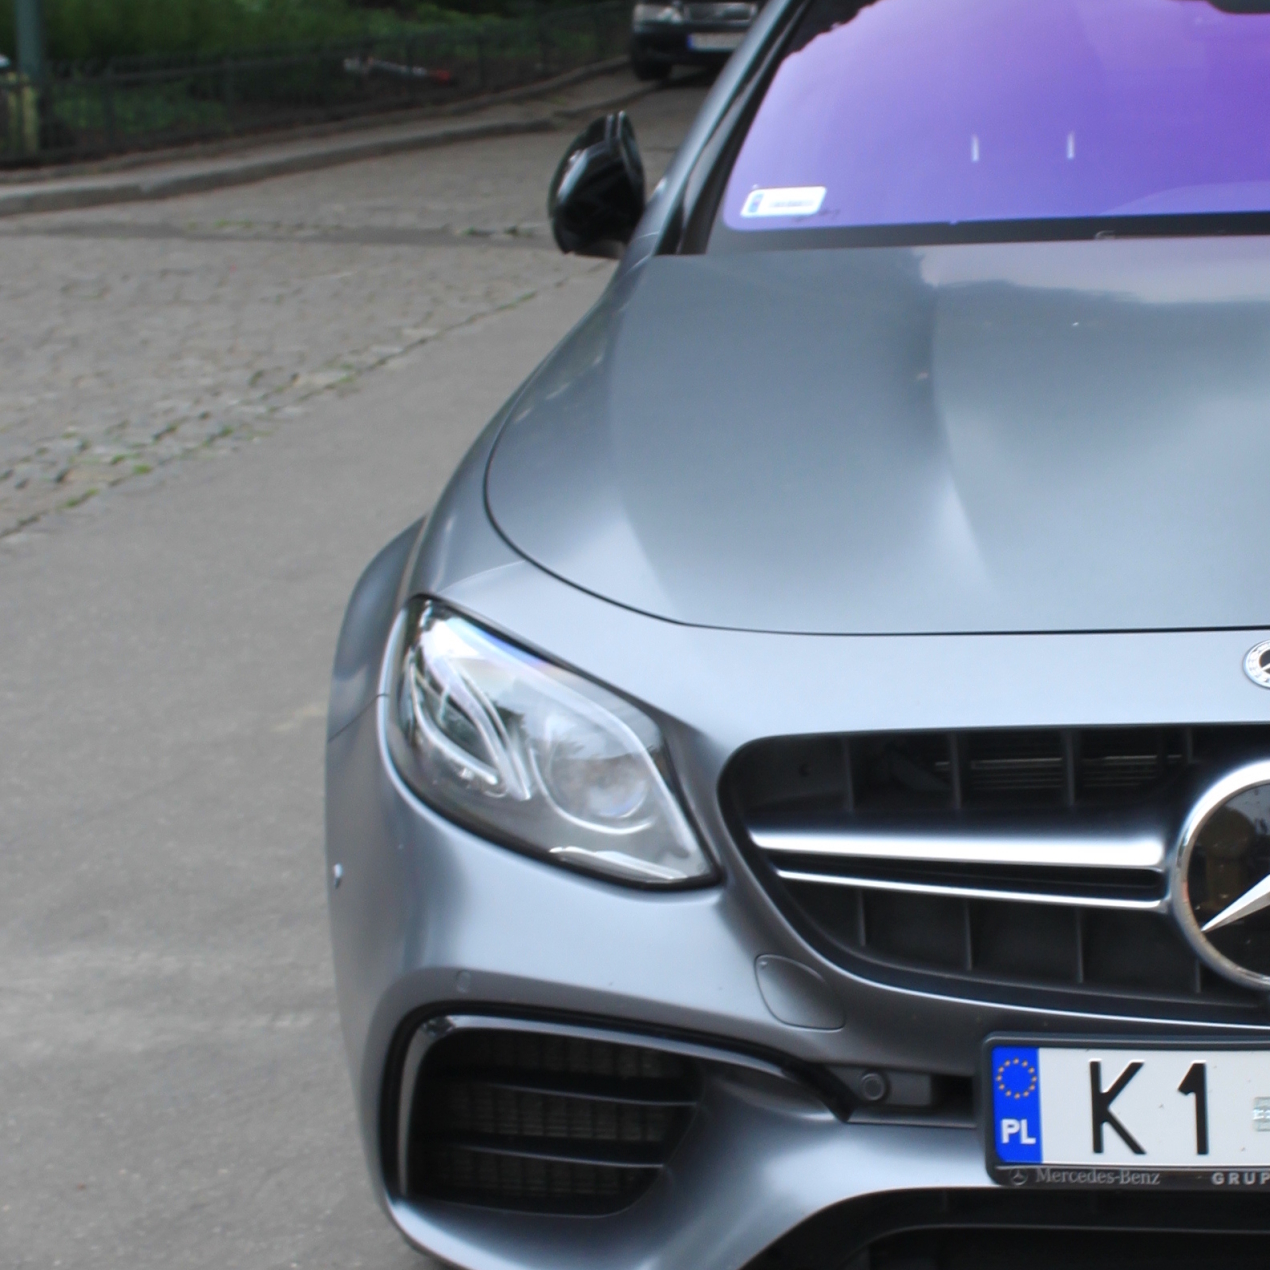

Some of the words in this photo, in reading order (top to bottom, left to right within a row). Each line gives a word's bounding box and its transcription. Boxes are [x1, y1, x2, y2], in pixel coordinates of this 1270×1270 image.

[1089, 1060, 1209, 1155] K1
[1002, 1120, 1036, 1145] PL
[1036, 1168, 1161, 1185] Mercedes-Benz
